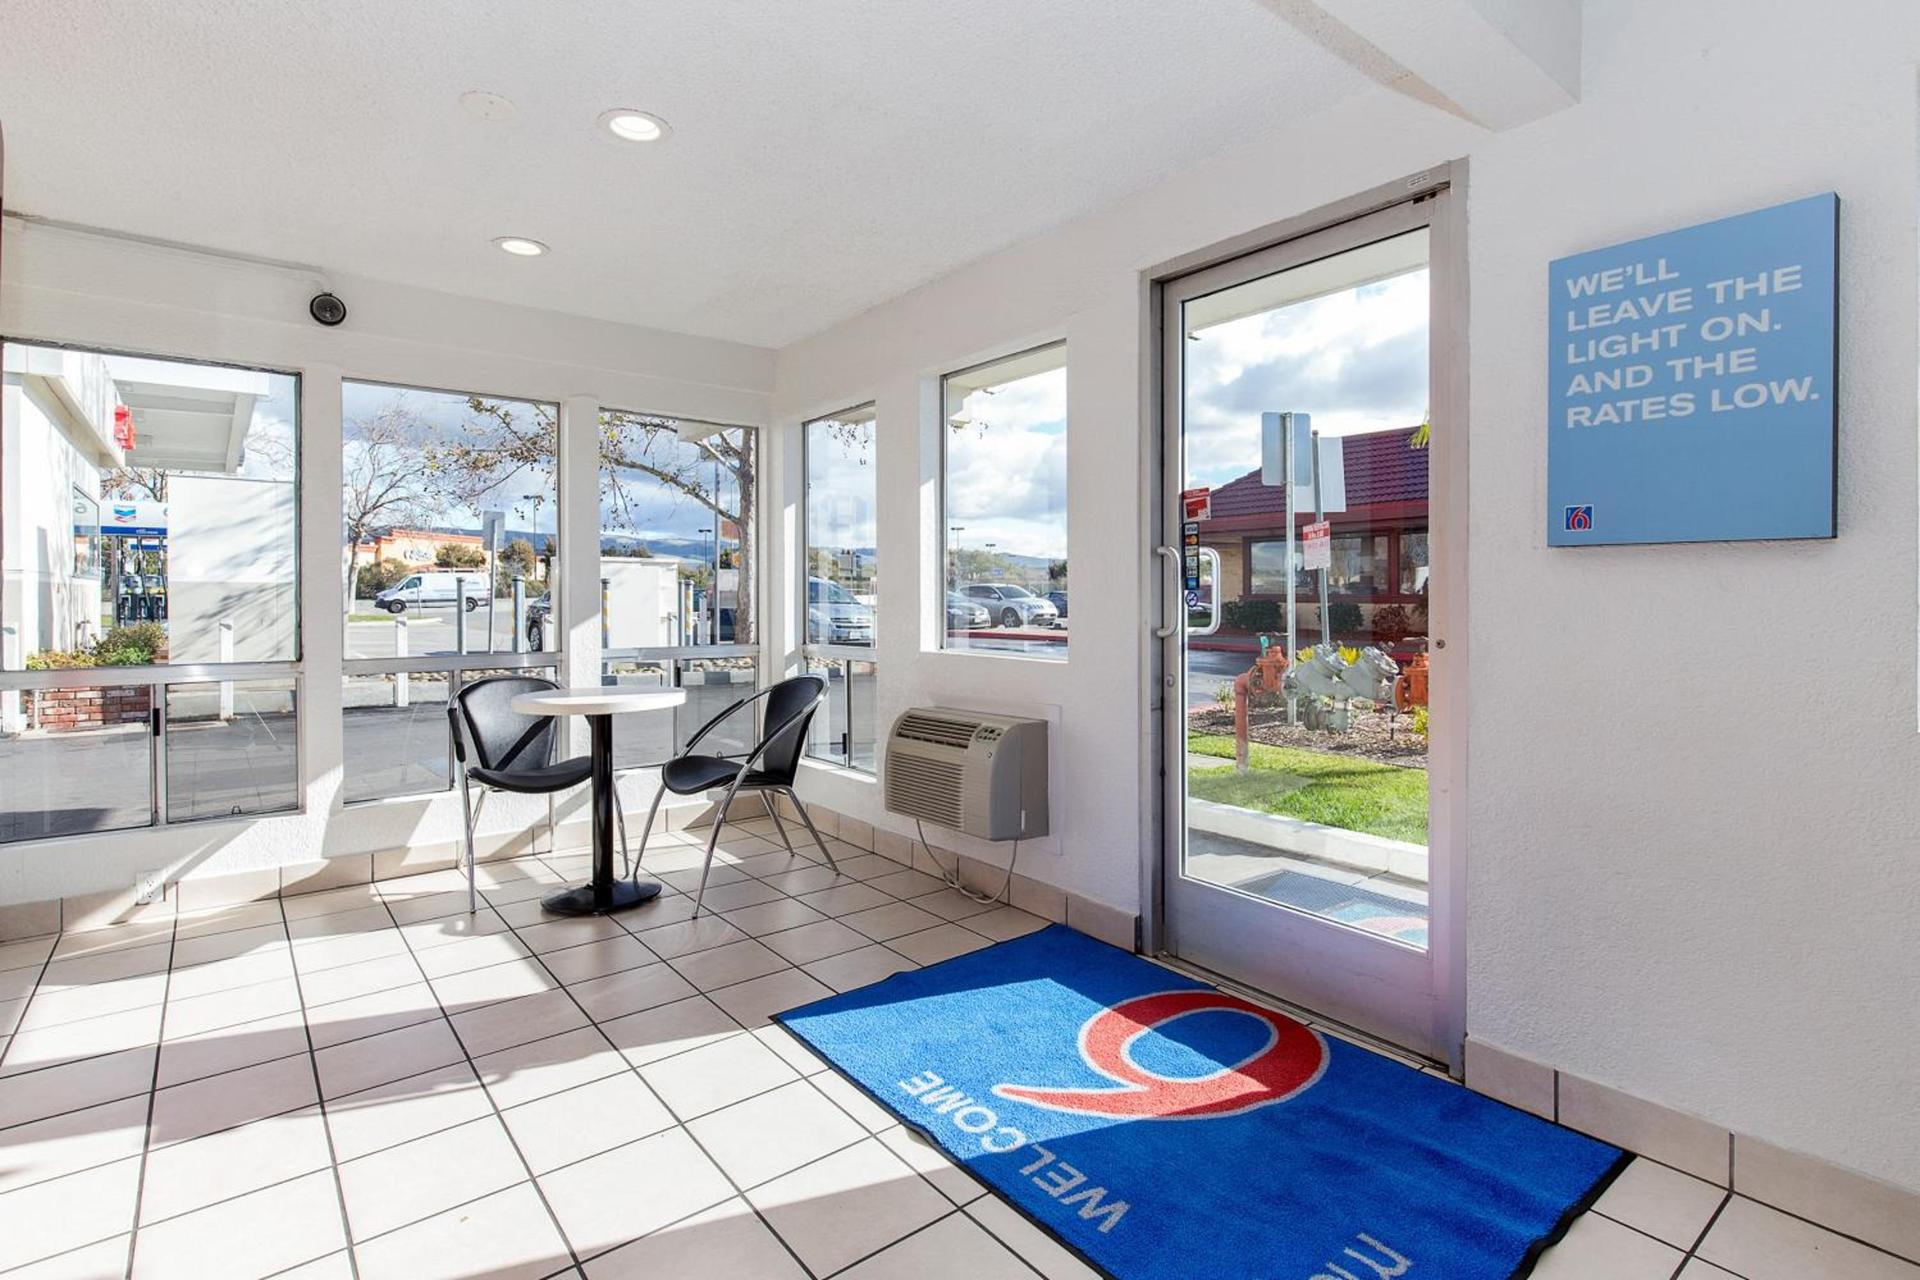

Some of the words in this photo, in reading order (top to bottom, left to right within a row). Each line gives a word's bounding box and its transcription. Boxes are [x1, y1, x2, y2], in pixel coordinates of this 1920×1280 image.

[1566, 258, 1679, 299] WE'LL
[1567, 287, 1694, 332] LEAVE
[1706, 265, 1803, 305] THE
[1567, 323, 1687, 365] LIGHT
[1700, 308, 1782, 343] ON.
[1565, 365, 1653, 397] AND
[1666, 347, 1758, 382] THE
[1566, 393, 1696, 429] RATES
[1711, 376, 1820, 412] LOW.
[991, 989, 1331, 1121] 6
[898, 1071, 1131, 1233] WELCOME
